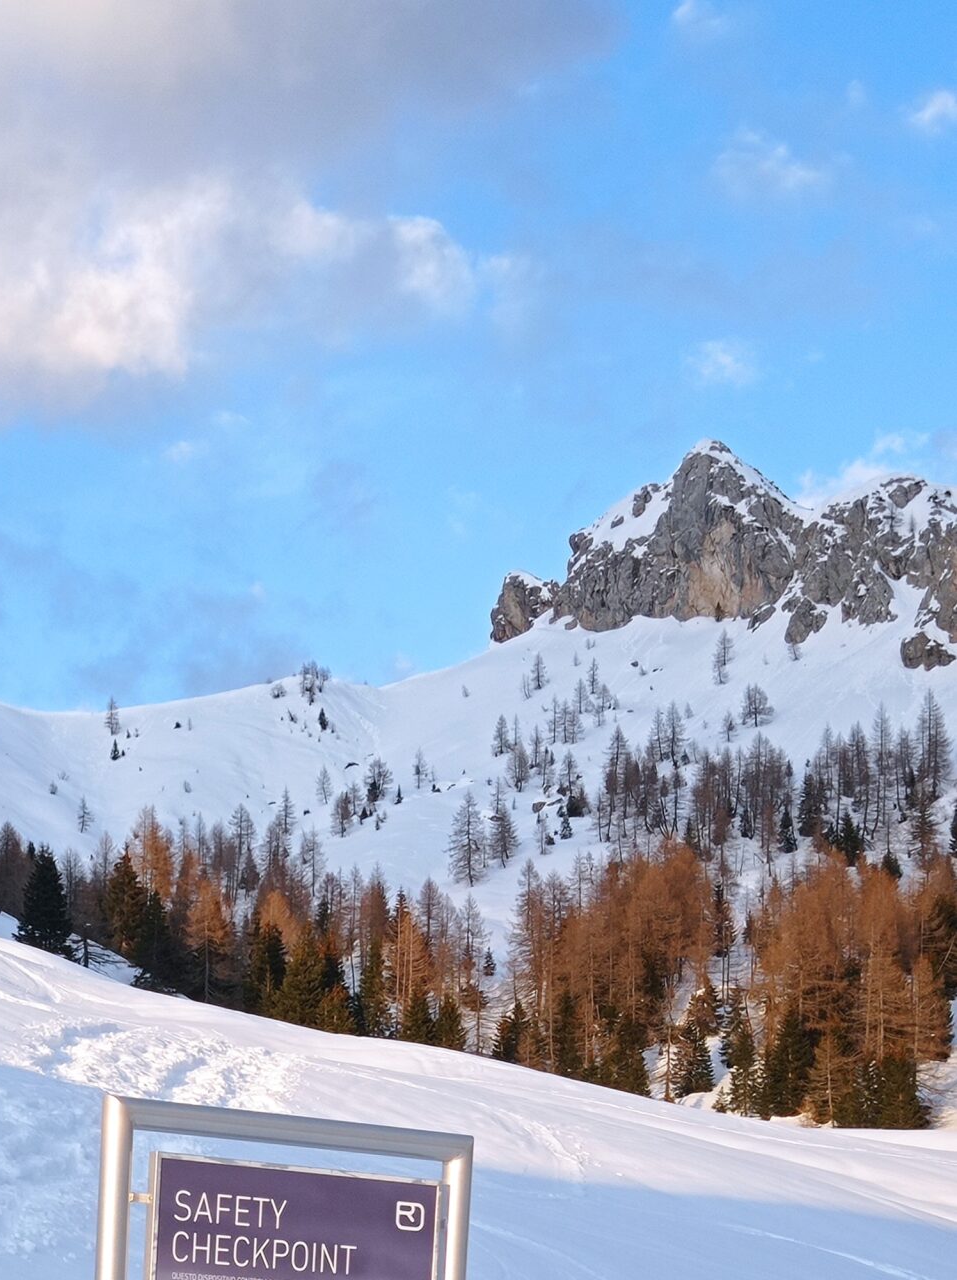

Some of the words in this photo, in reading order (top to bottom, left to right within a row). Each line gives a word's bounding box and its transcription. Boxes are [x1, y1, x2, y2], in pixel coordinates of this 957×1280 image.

[174, 1190, 287, 1229] SAFETY
[172, 1231, 357, 1275] CHECKPOINT
[171, 1272, 197, 1280] QUESTO
